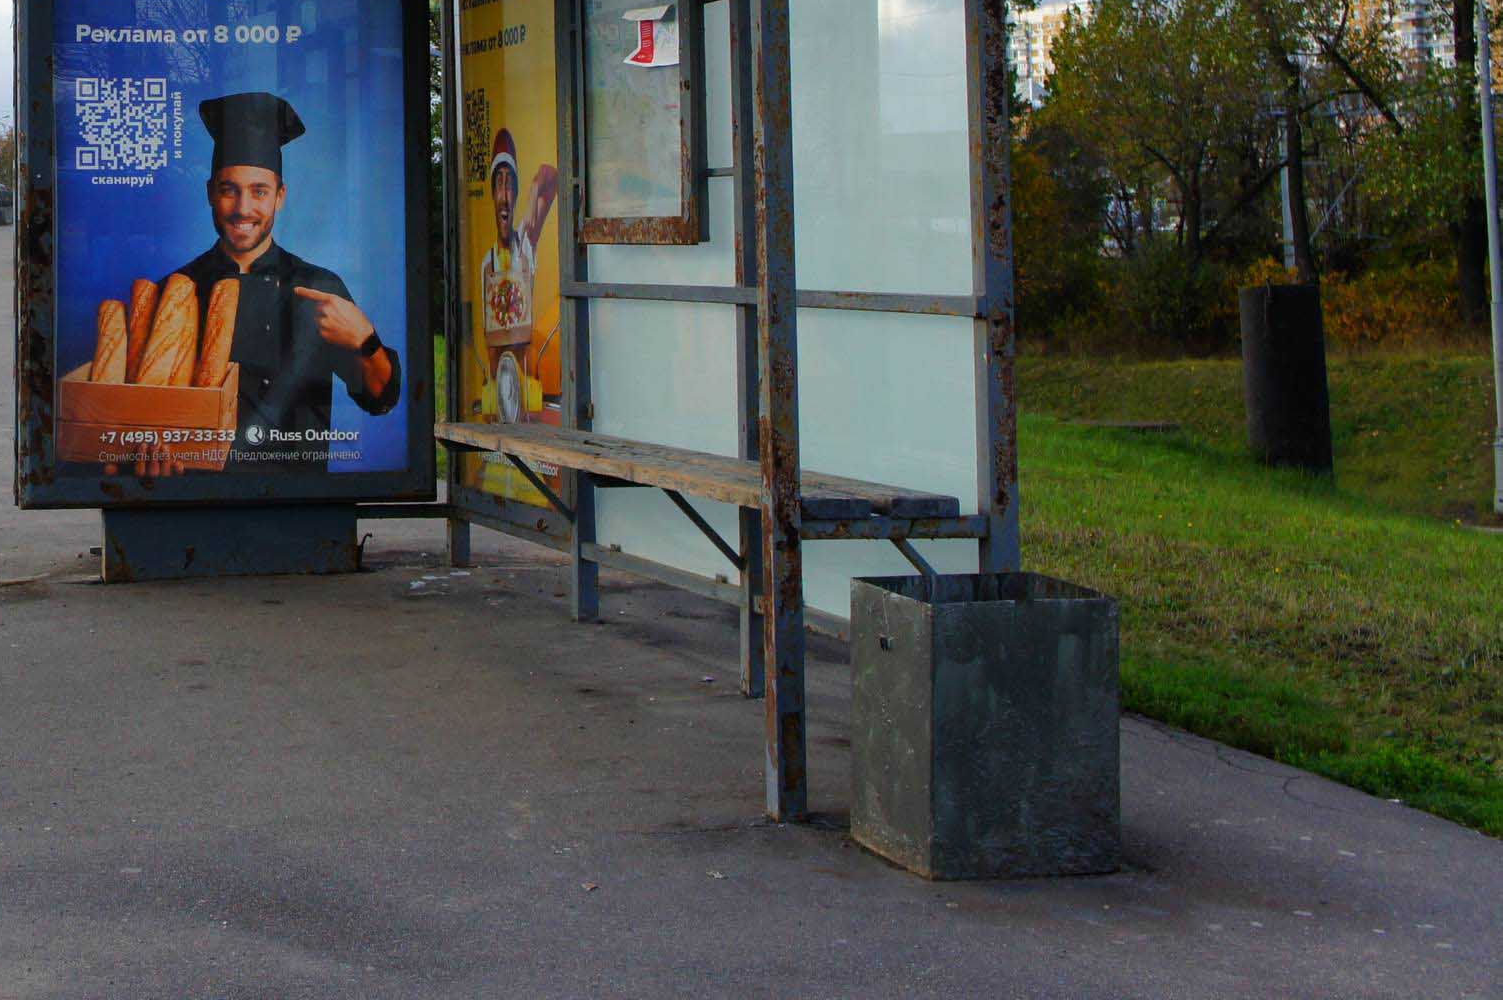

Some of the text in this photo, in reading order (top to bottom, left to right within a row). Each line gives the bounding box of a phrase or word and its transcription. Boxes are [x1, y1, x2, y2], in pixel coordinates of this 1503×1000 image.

[75, 23, 176, 44] Реклама
[182, 27, 208, 44] от
[213, 24, 229, 44] 8
[235, 24, 281, 44] 000
[171, 91, 184, 159] и покупай
[91, 173, 154, 187] сканируй
[99, 429, 236, 446] +7 (495) 937-33-33
[269, 428, 359, 442] Russ Outdoor
[230, 449, 300, 463] Предложение
